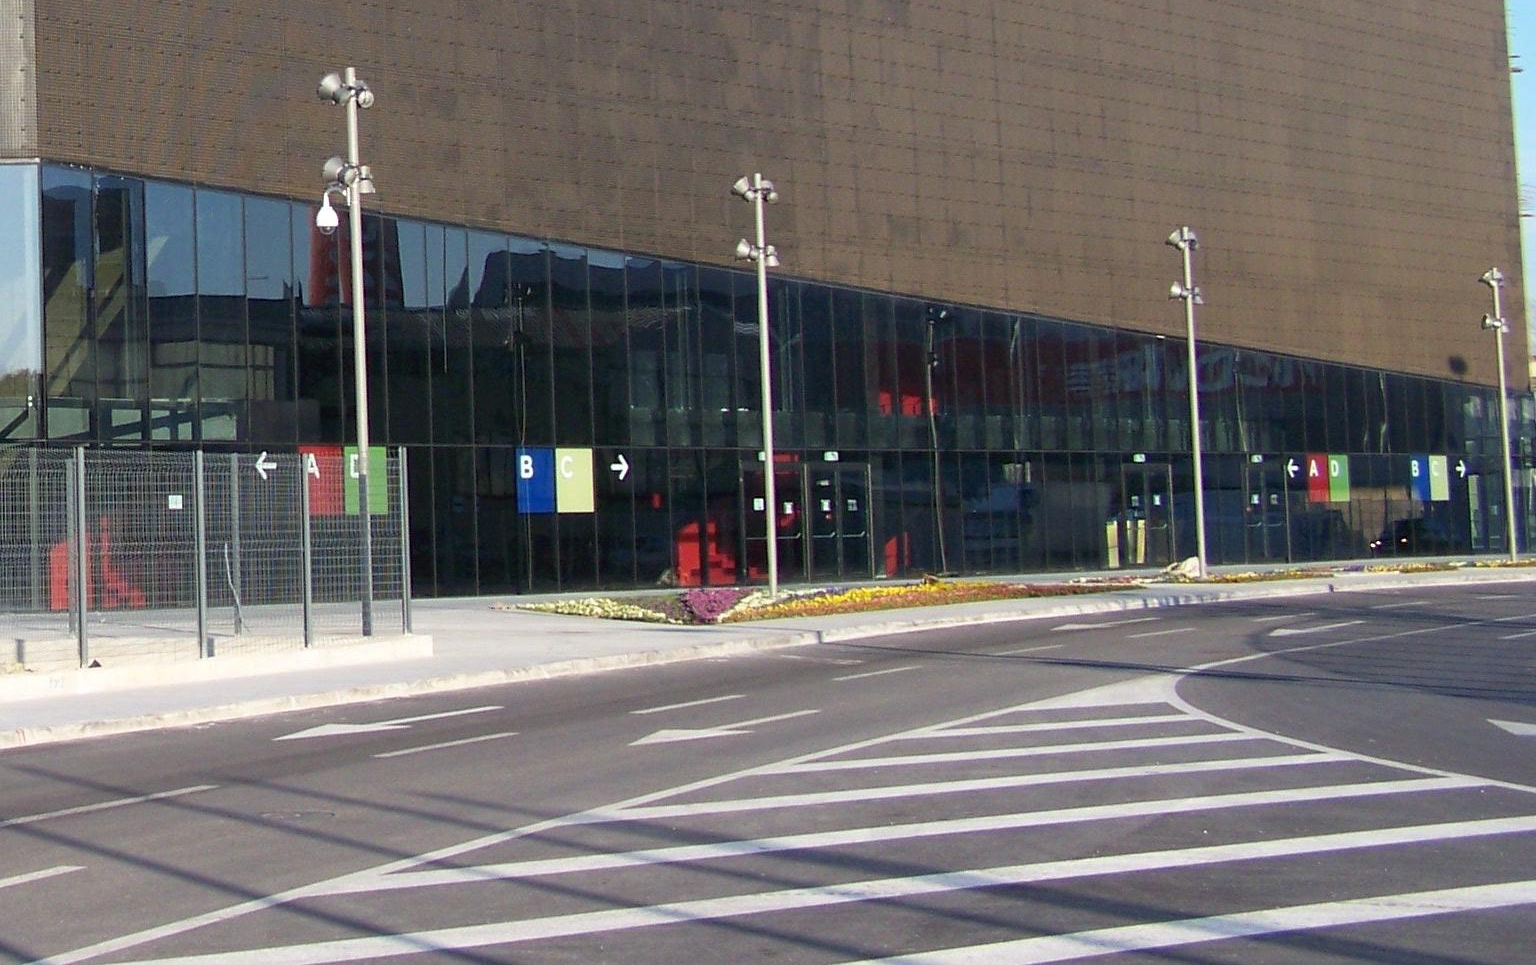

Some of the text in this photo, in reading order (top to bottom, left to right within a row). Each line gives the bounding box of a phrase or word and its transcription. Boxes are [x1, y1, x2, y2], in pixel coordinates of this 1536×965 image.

[307, 453, 320, 479] A
[520, 454, 574, 479] B C
[1309, 459, 1339, 477] A D
[1411, 459, 1440, 477] B C
